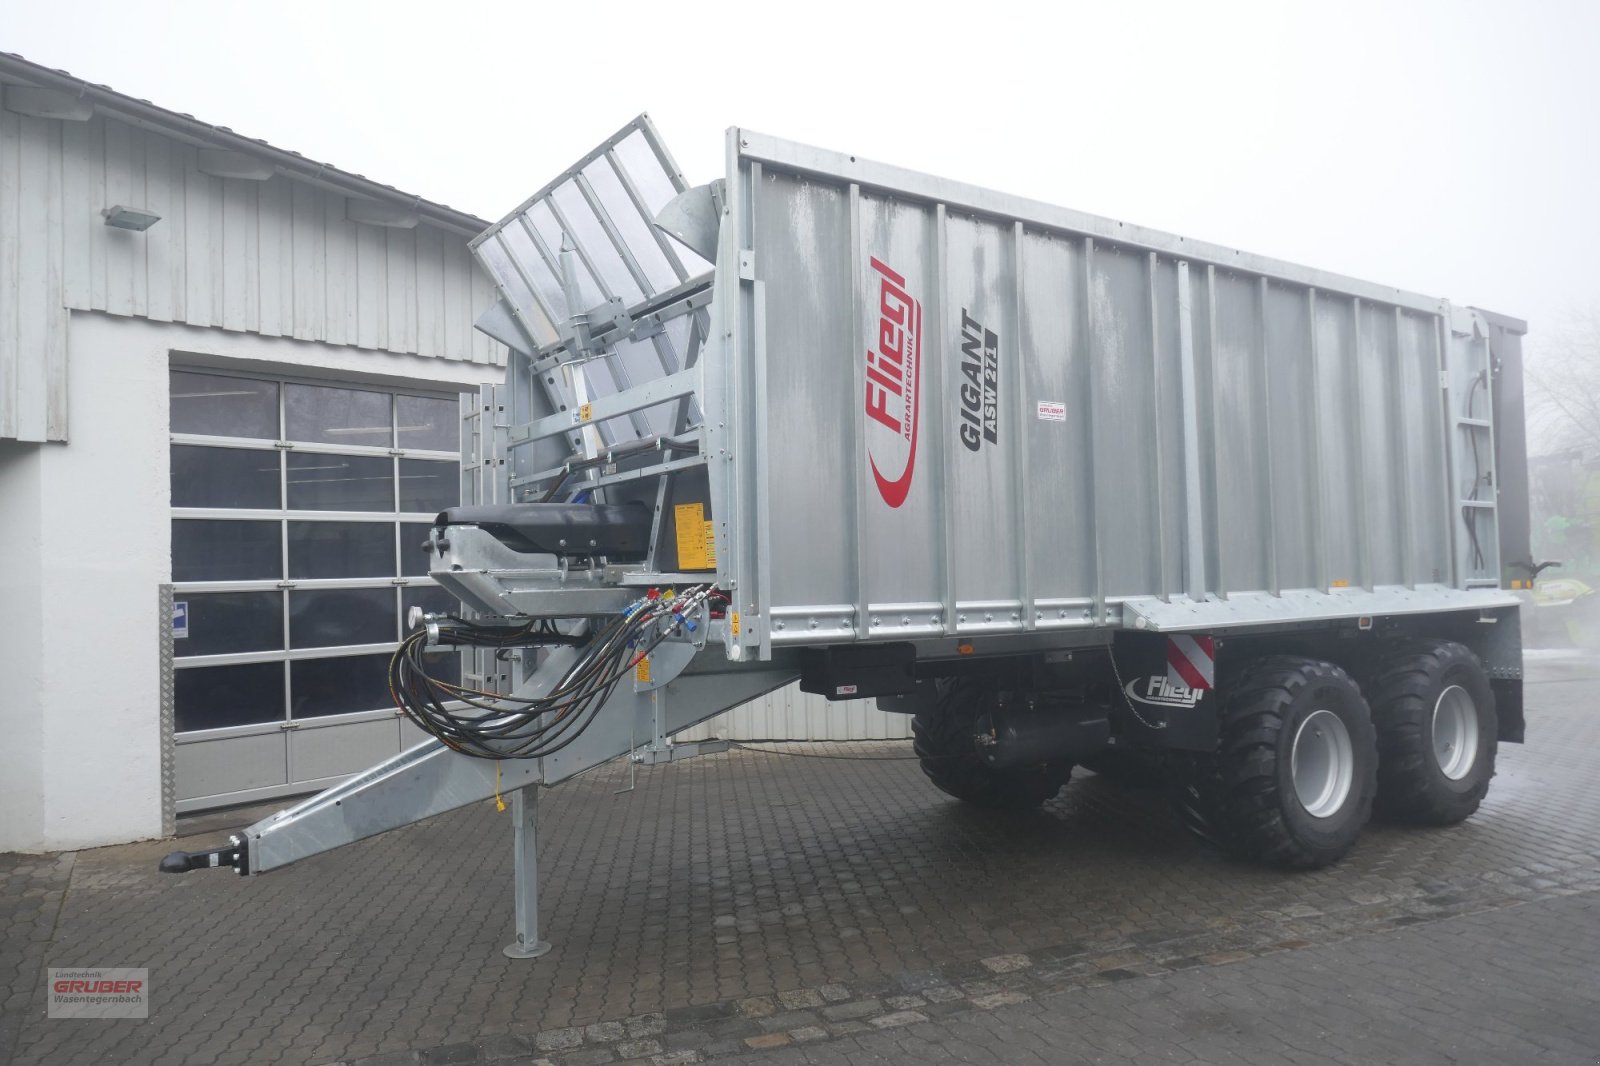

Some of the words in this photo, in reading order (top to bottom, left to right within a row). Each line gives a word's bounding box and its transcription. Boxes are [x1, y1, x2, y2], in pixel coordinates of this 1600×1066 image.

[865, 255, 914, 435] Fliegl
[904, 336, 914, 442] AGRARTECHNIK
[960, 307, 982, 452] GIGANT
[984, 347, 997, 383] 271
[984, 384, 997, 434] ASW
